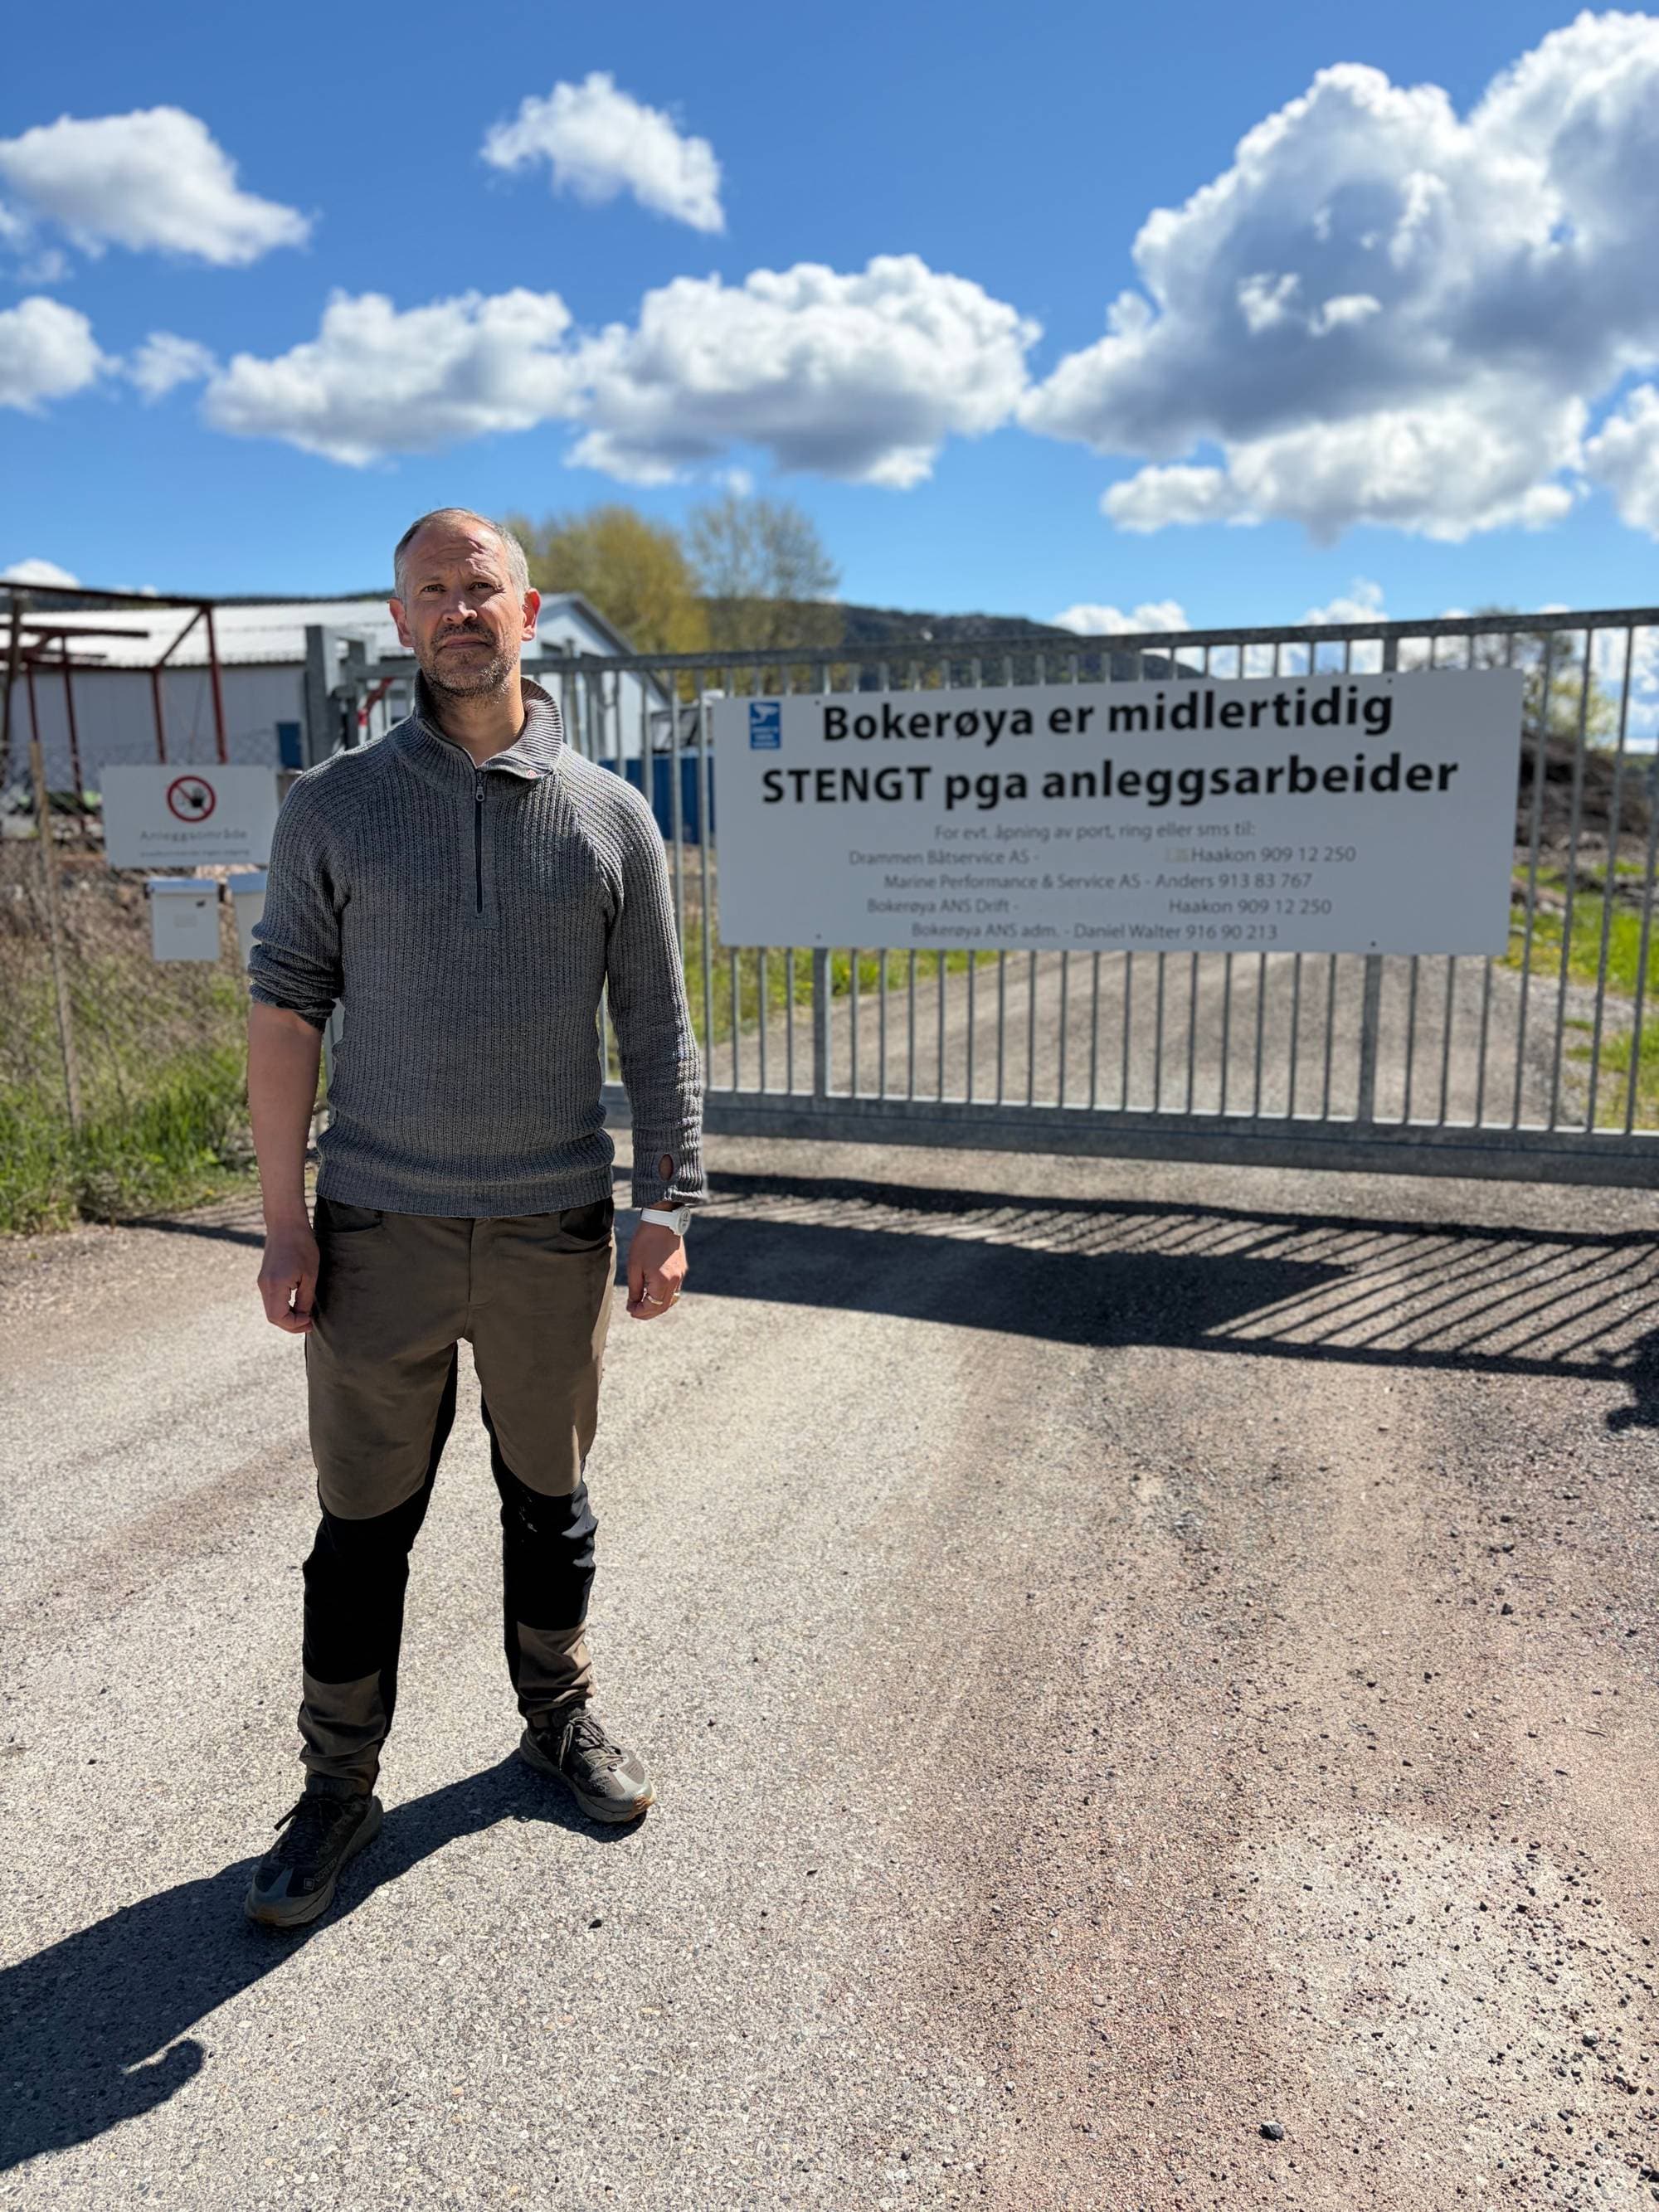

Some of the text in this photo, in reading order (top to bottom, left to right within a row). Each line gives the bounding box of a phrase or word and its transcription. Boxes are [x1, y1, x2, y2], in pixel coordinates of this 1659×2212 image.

[825, 703, 1033, 746] Bokerøya
[1048, 707, 1094, 734] er
[1109, 685, 1392, 736] midlertidig
[763, 752, 1457, 810] STENGT pga anleggsarbeider
[935, 825, 959, 840] For
[995, 824, 1050, 843] åpning
[1054, 827, 1072, 839] av
[1119, 824, 1152, 843] ring
[1156, 823, 1192, 838] eller
[1197, 824, 1230, 837] sms
[1234, 820, 1256, 836] til:
[849, 850, 923, 865] Drammen
[927, 849, 1005, 865] Båtservice
[1009, 849, 1029, 864] AS
[1191, 848, 1256, 863] Haakon
[1261, 847, 1292, 863] 909
[1299, 847, 1318, 863] 12
[1324, 846, 1356, 863] 250
[884, 875, 937, 889] Marine
[940, 873, 1038, 889] Performance
[1042, 874, 1053, 889] &
[1058, 873, 1115, 889] Service
[1119, 874, 1141, 888] AS
[1155, 873, 1214, 889] Anders
[1219, 873, 1249, 888] 913
[1254, 873, 1275, 888] 83
[1282, 873, 1312, 889] 767
[868, 898, 936, 916] Bokerøya
[940, 898, 971, 913] ANS
[975, 898, 1009, 913] Drift
[1170, 899, 1233, 914] Haakon
[1238, 899, 1269, 914] 909
[1276, 898, 1295, 915] 12
[1300, 898, 1332, 915] 250
[912, 922, 981, 940] Bokerøya
[985, 923, 1017, 937] ANS
[1021, 924, 1059, 938] adm.
[1073, 923, 1125, 939] Daniel
[1129, 925, 1180, 939] Walter
[1185, 924, 1217, 940] 916
[1221, 925, 1243, 940] 90
[1247, 925, 1277, 941] 213
